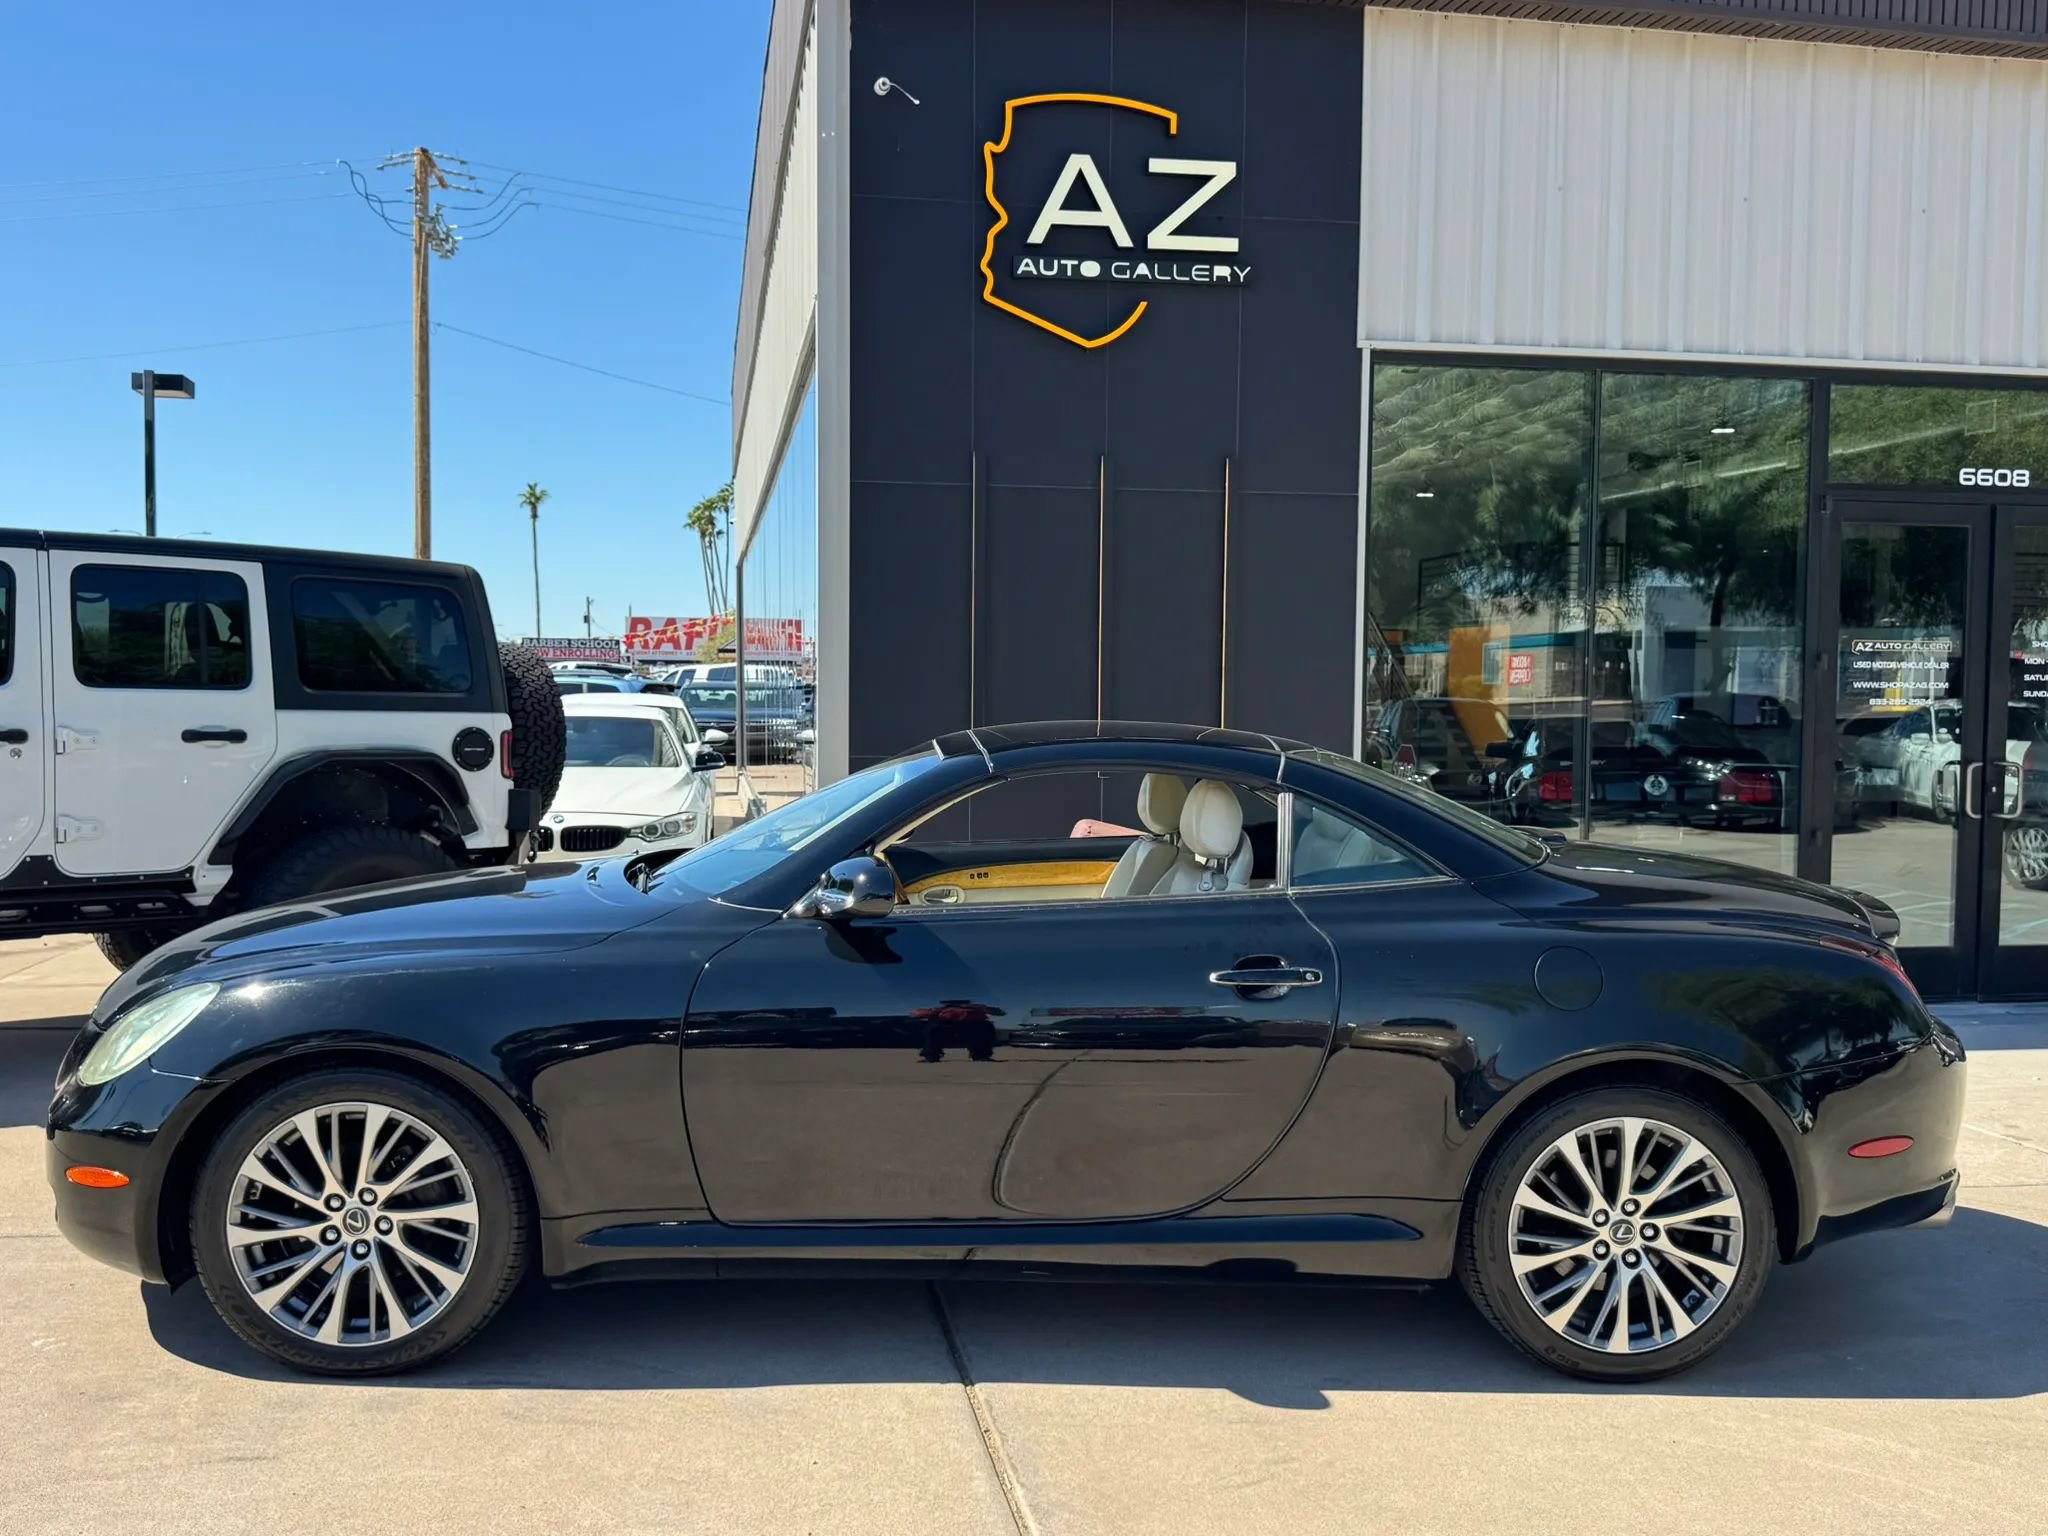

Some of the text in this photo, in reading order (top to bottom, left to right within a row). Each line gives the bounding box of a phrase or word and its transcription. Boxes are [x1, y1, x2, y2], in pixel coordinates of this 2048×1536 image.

[1026, 153, 1239, 252] AZ
[1016, 258, 1251, 282] AUTO GALLERY
[1959, 468, 2030, 487] 6608
[523, 638, 618, 649] BARBER SCHOOL
[1855, 643, 1873, 651] AZ
[1903, 643, 1950, 651] GALLERY
[1872, 661, 1896, 669] MOTOR
[1924, 661, 1949, 669] DEALER
[2025, 657, 2045, 665] MON
[2023, 690, 2048, 698] SUND
